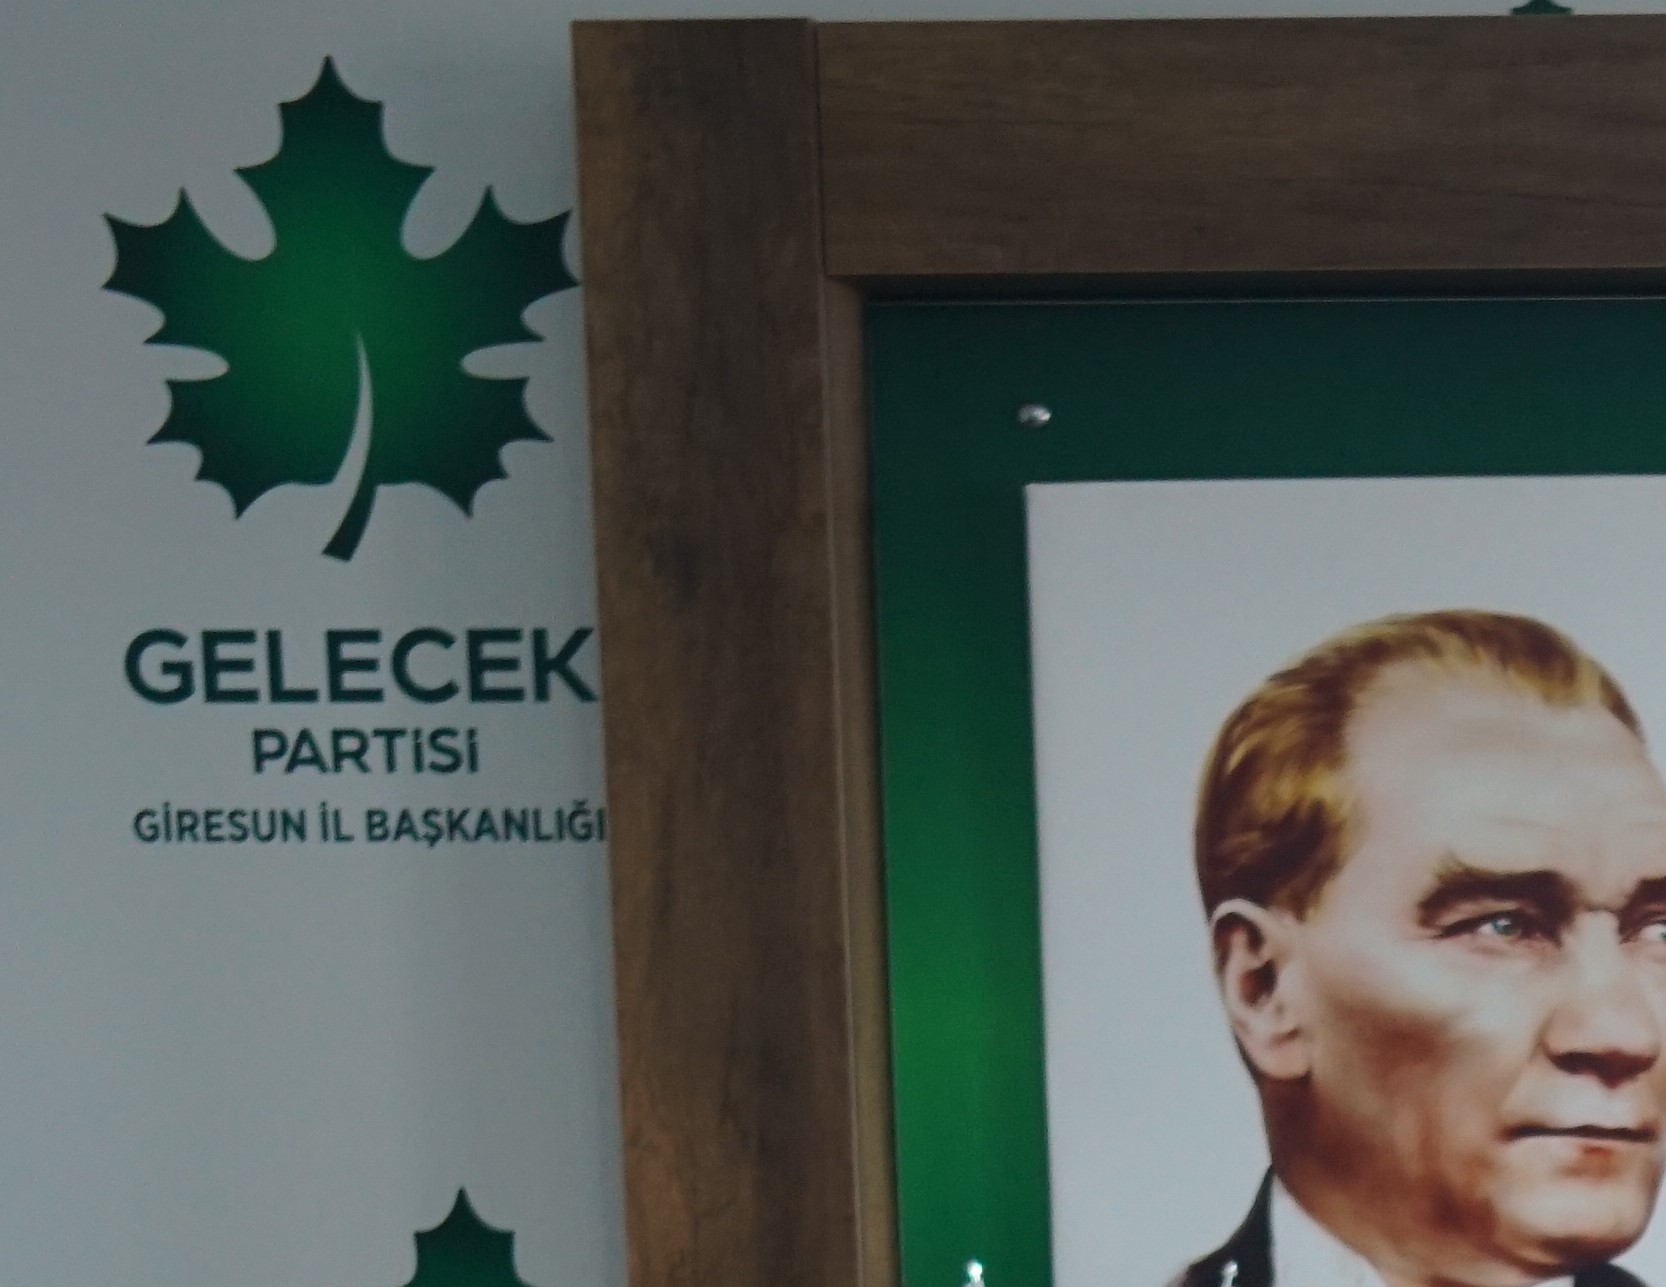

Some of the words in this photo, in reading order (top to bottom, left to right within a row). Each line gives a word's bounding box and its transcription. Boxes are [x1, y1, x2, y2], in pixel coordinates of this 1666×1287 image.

[124, 626, 598, 704] GELECEK
[133, 801, 306, 844] GİRESUN
[320, 801, 354, 843] İL
[366, 799, 606, 848] BAŞKANLIĞI
